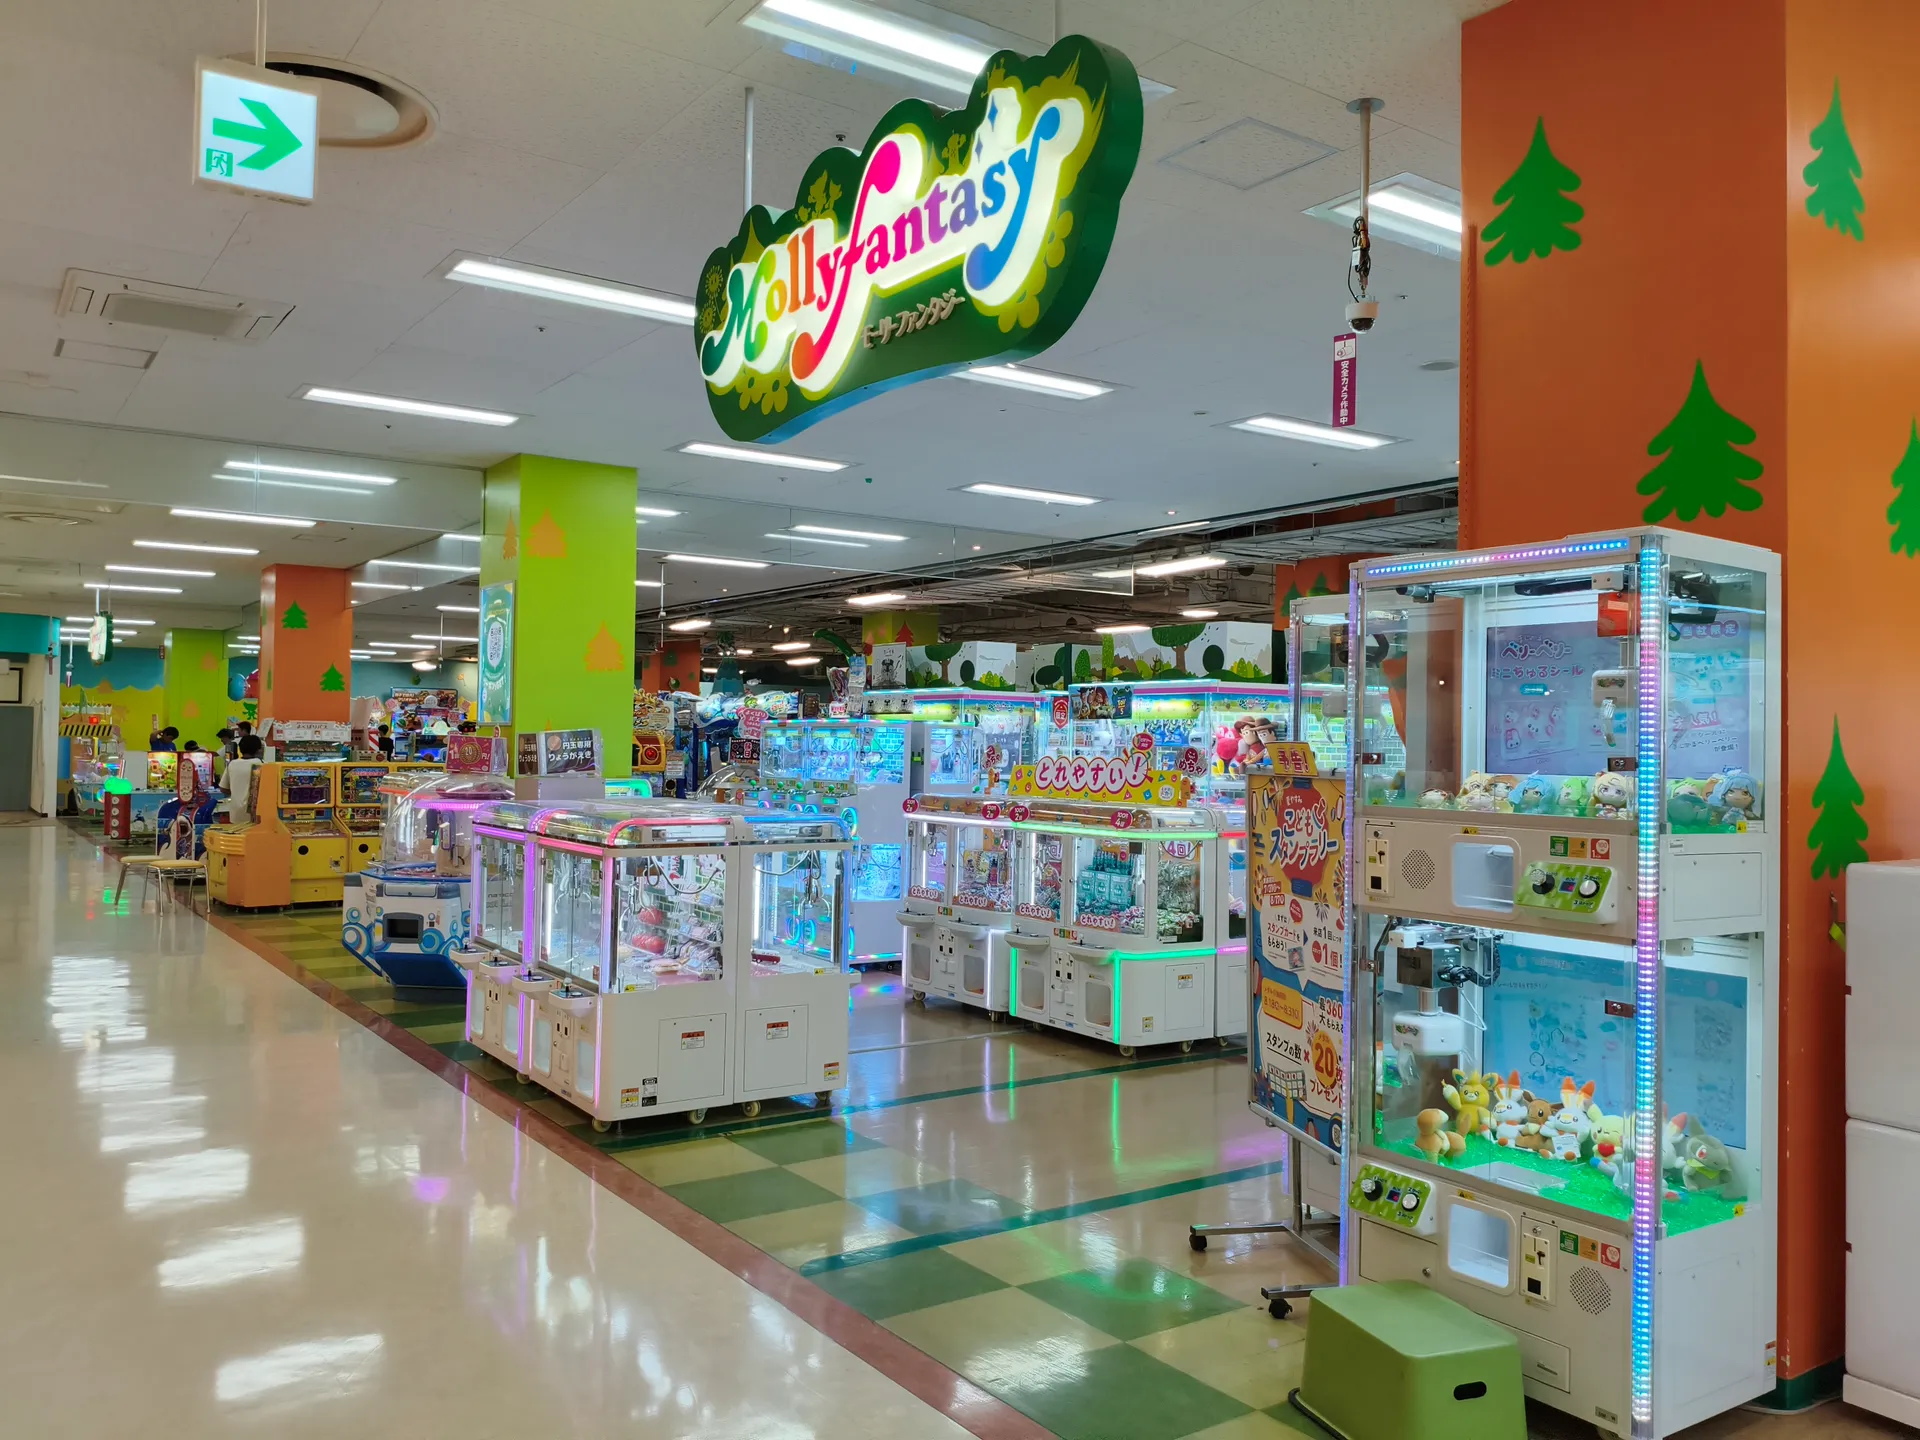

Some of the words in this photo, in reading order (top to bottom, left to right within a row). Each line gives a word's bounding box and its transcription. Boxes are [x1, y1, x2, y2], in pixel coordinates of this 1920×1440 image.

[861, 288, 966, 349] モーリーファンタジー
[1038, 759, 1141, 787] とれやすい!
[1278, 749, 1310, 773] 予告!
[1266, 1032, 1302, 1060] スタンプの数
[1315, 1042, 1334, 1078] 20
